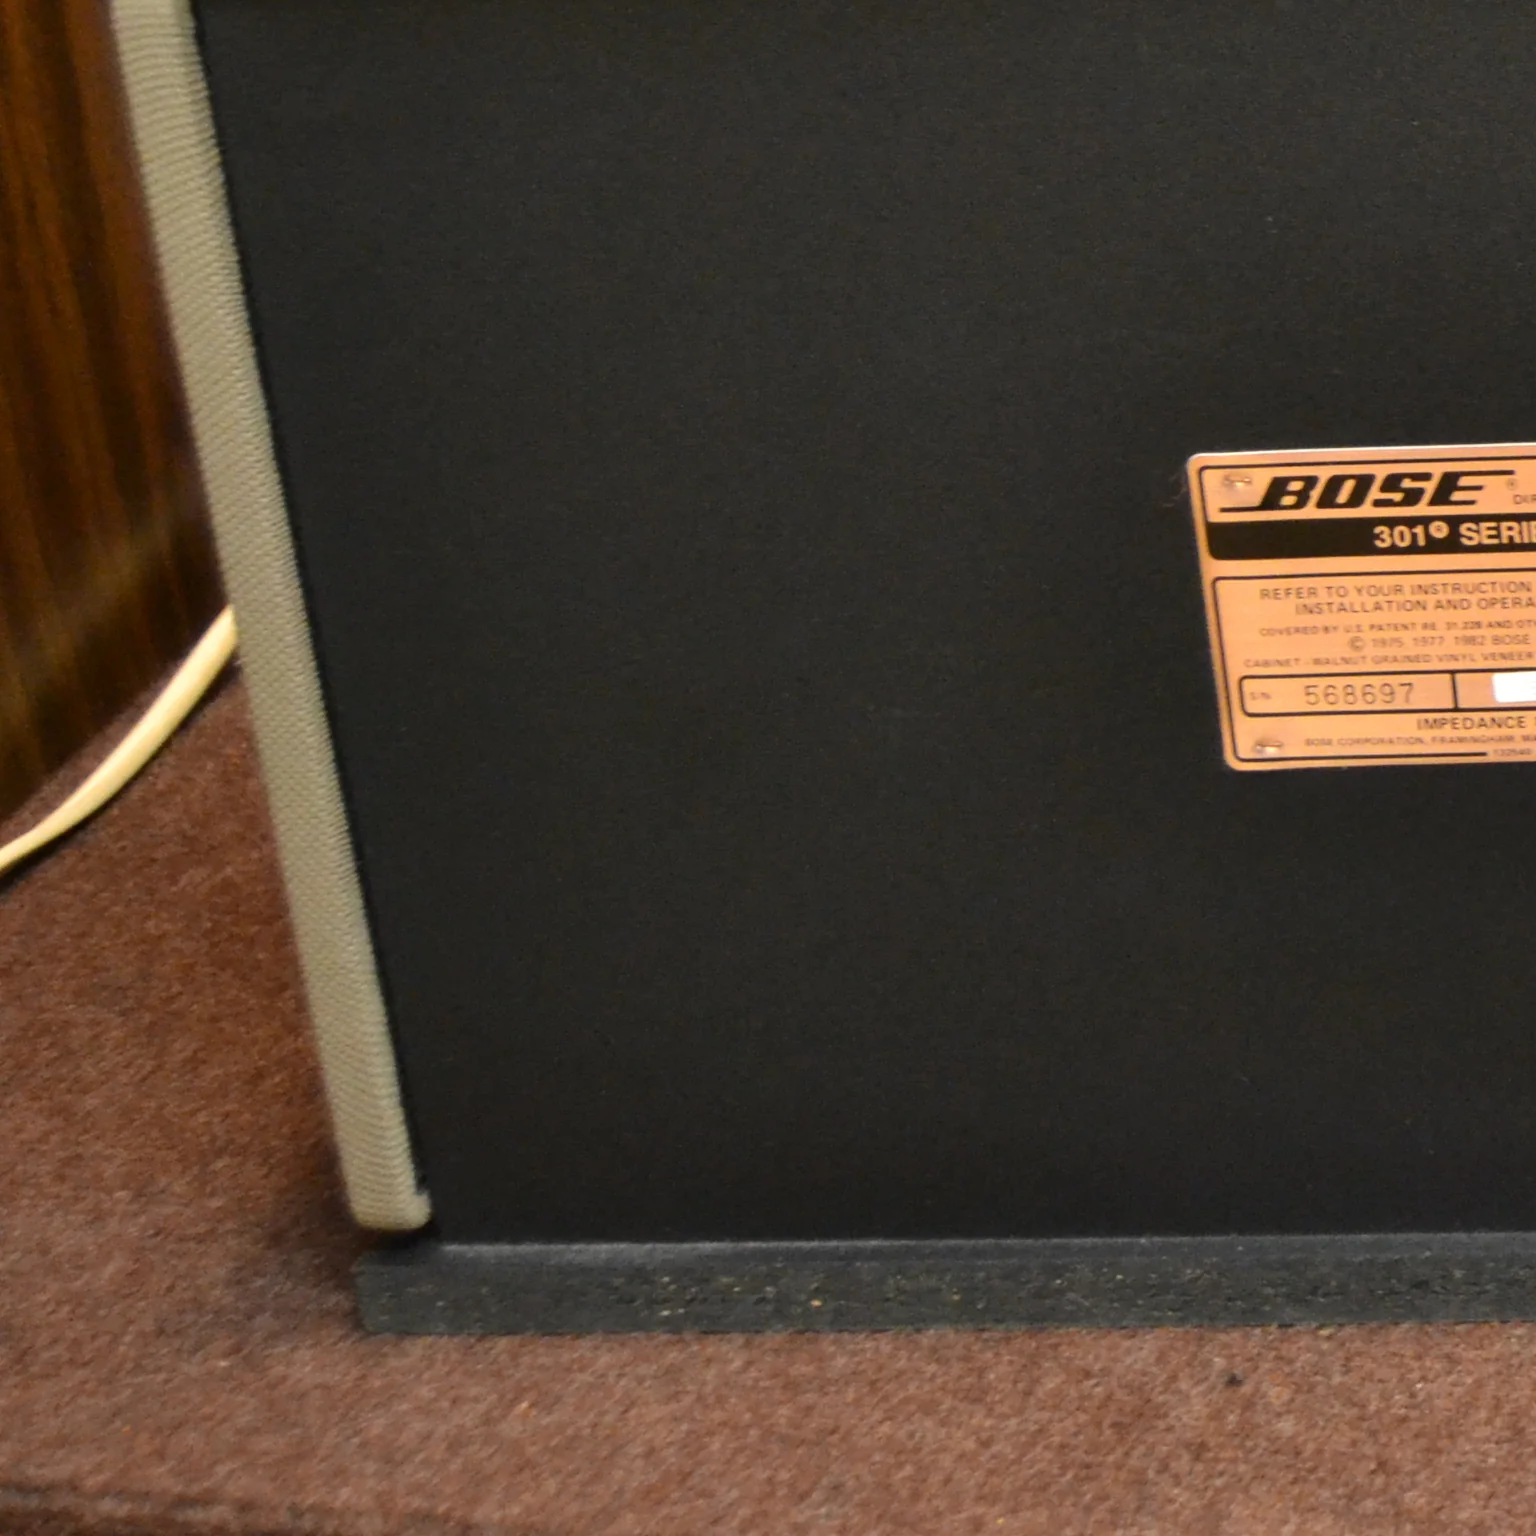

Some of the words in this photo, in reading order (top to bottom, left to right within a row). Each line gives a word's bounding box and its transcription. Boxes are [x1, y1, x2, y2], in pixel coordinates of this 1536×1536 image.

[1259, 586, 1319, 601] REFER
[1326, 585, 1349, 599] TO
[1354, 583, 1405, 598] YOUR
[1410, 580, 1533, 596] INSTRUCTION
[1295, 598, 1429, 615] INSTALLATION
[1434, 597, 1472, 612] AND
[1259, 625, 1322, 637] COVERED
[1323, 624, 1339, 636] BY
[1369, 621, 1417, 633] PATENT
[1486, 618, 1514, 630] AND
[1491, 632, 1531, 645] BOSE
[1243, 657, 1301, 669] CABINET
[1312, 655, 1367, 667] WALNUT
[1371, 653, 1432, 665] GRAINED
[1435, 652, 1477, 664] VINYL
[1479, 650, 1534, 662] VENEER
[1303, 681, 1415, 706] 568697
[1416, 716, 1526, 731] IMPEDANCE
[1305, 736, 1335, 748] BOSE
